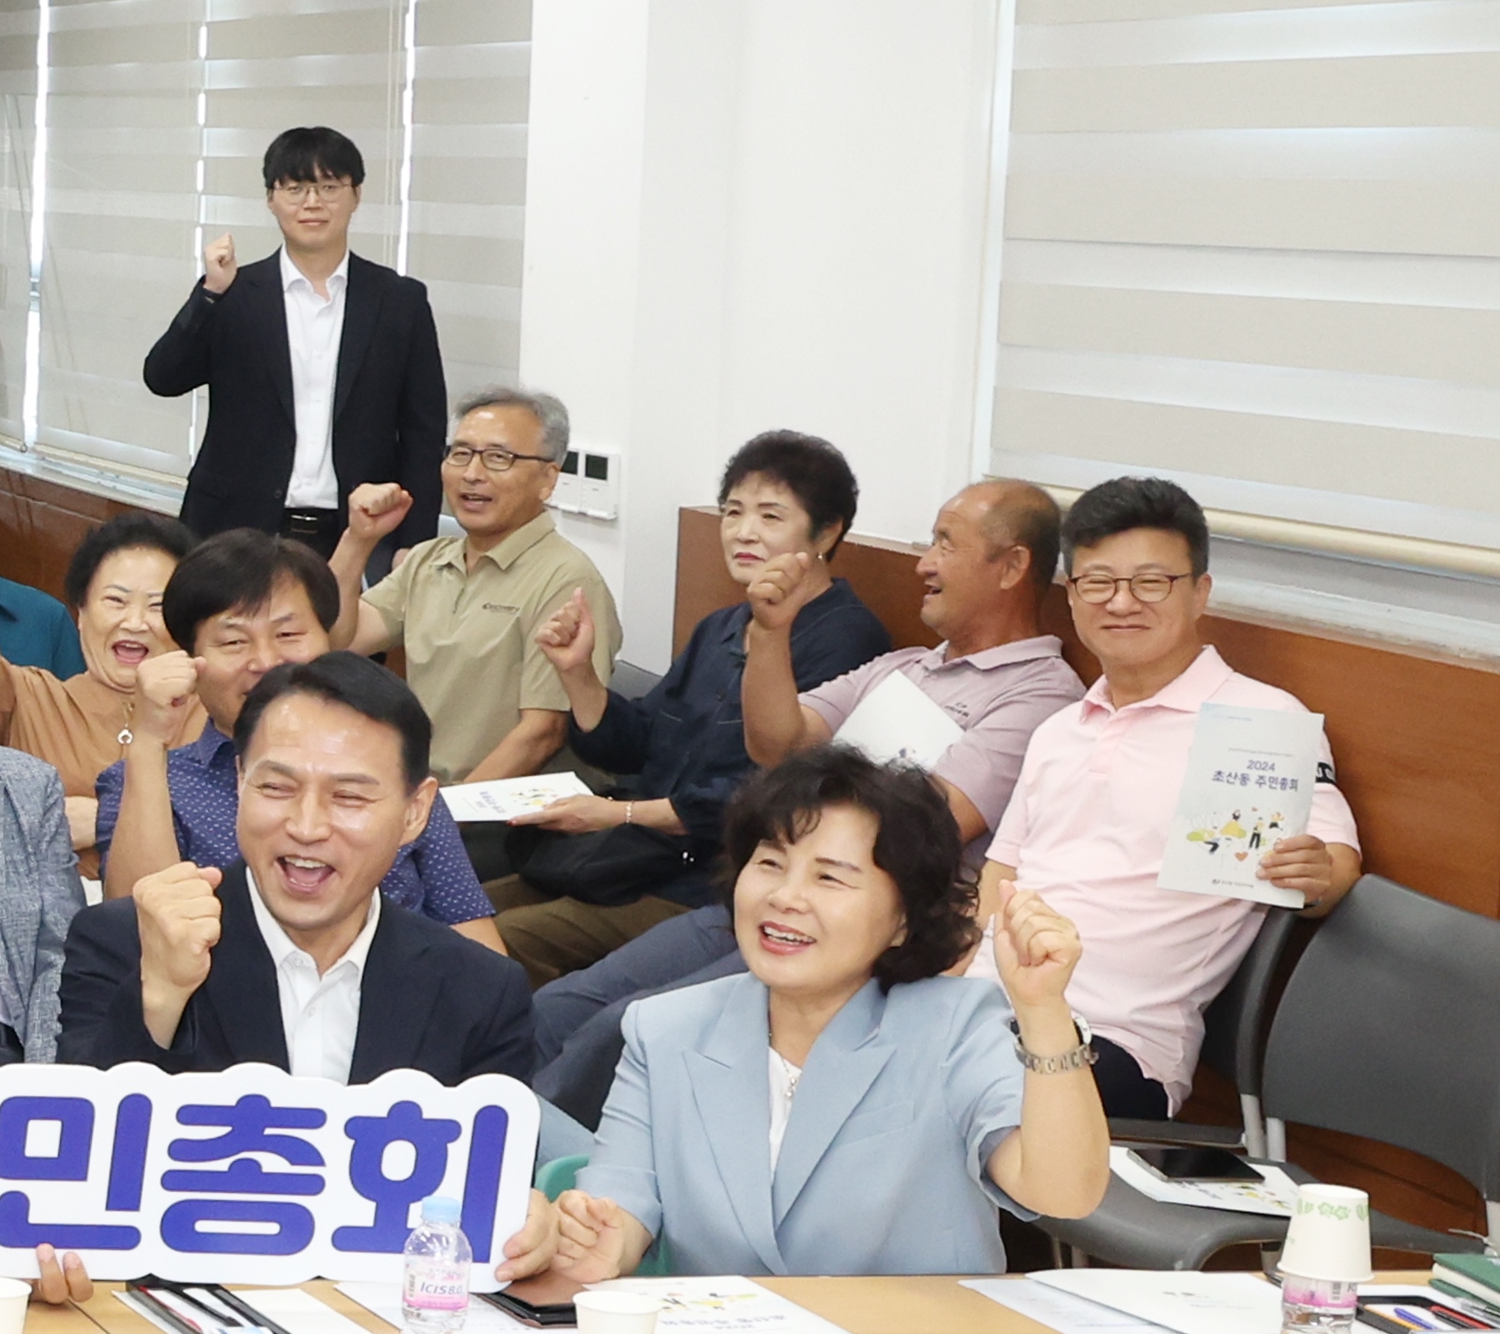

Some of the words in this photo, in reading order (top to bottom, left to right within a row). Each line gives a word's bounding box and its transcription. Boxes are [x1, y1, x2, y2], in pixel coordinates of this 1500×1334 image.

[1246, 759, 1276, 771] 2024
[1212, 770, 1251, 787] 초산동
[1255, 775, 1298, 792] 주민총회
